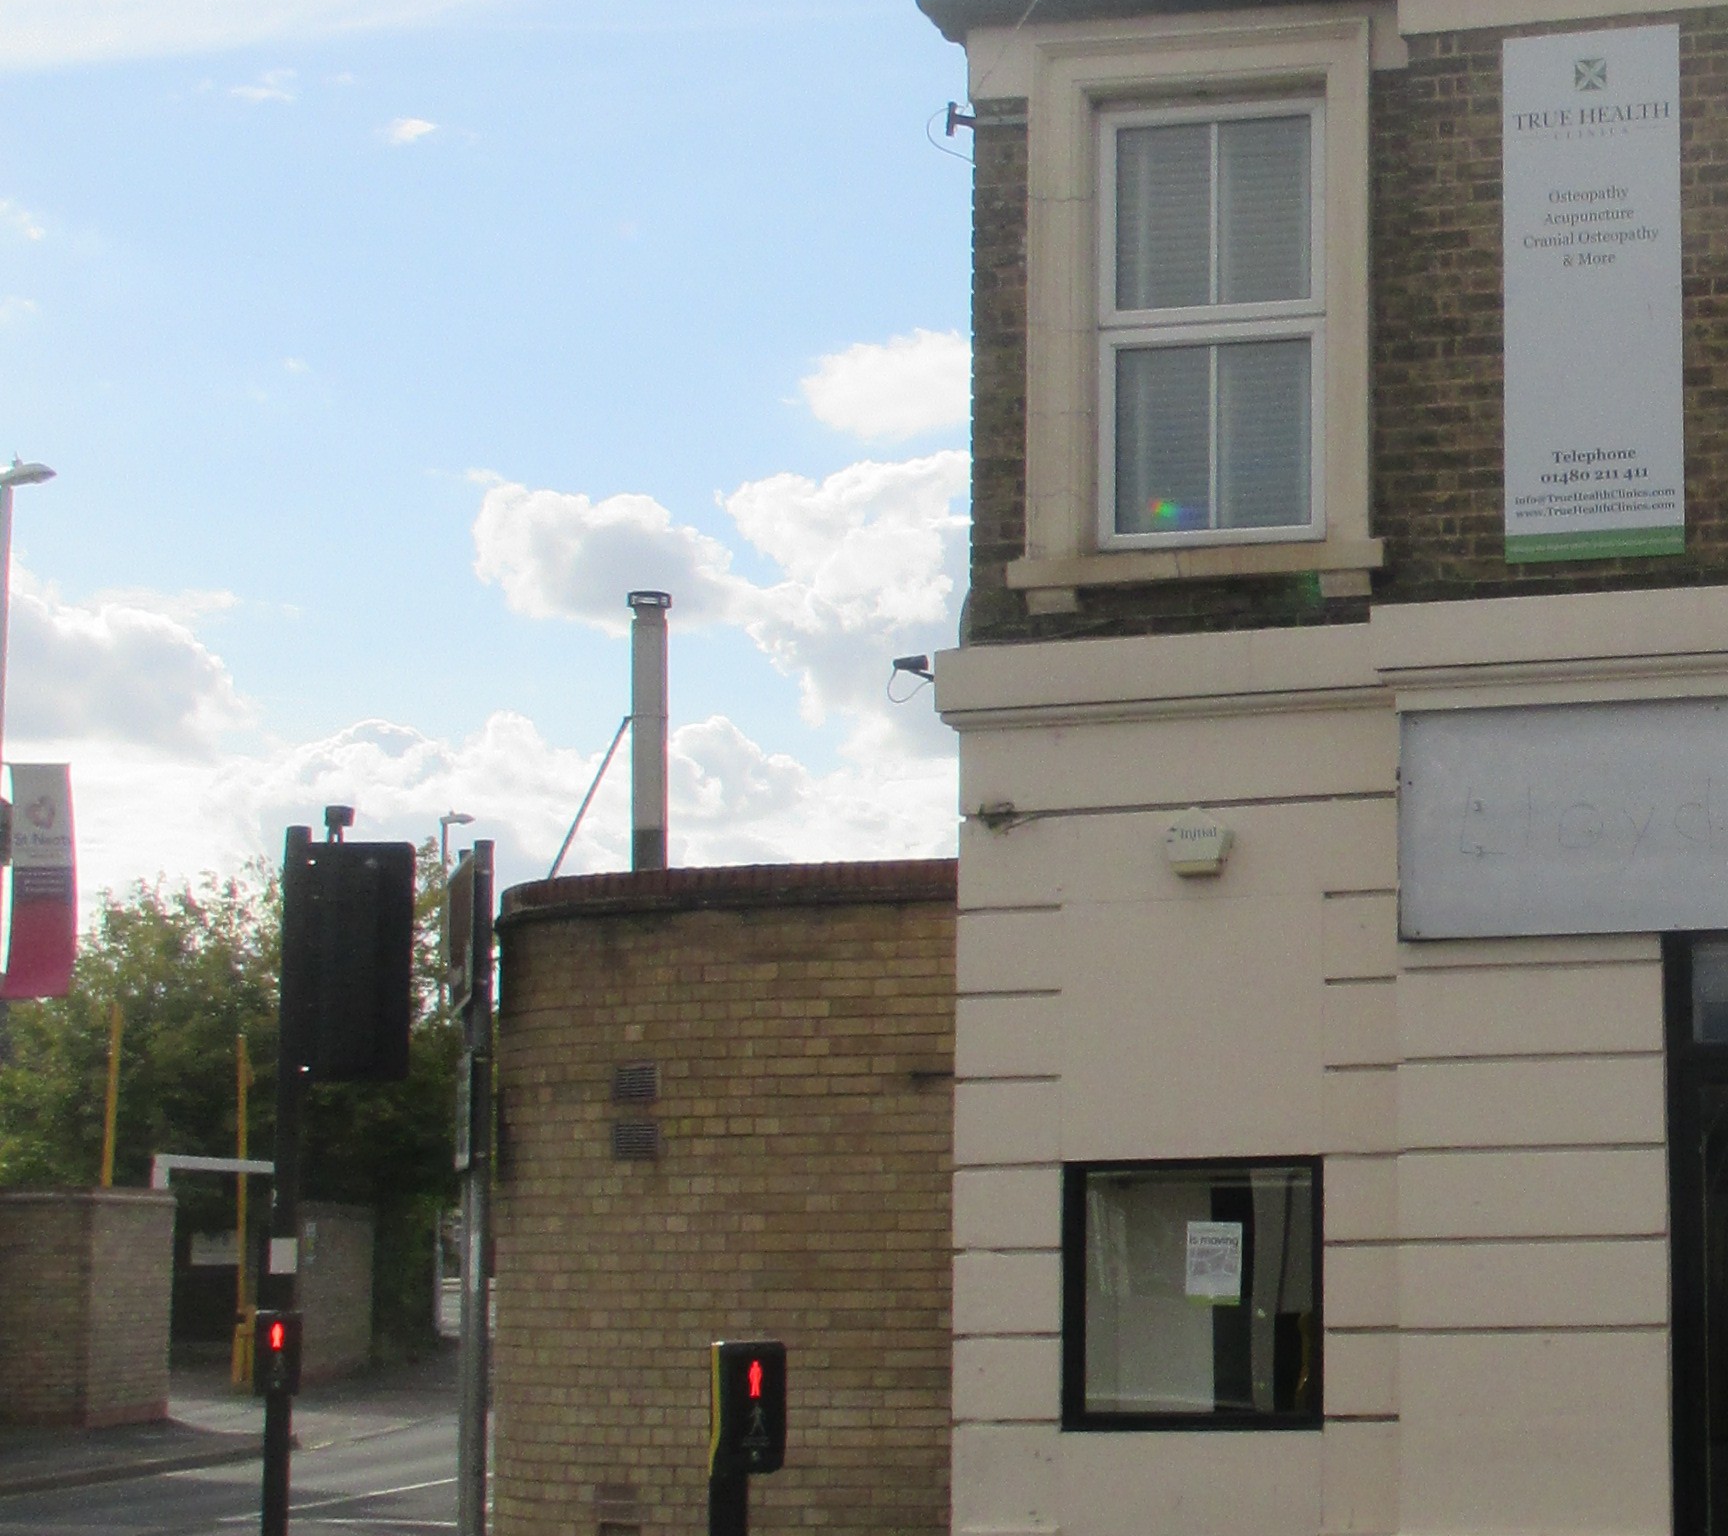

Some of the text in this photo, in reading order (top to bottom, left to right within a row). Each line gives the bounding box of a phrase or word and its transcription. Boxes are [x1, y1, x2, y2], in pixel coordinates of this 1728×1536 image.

[1512, 101, 1670, 131] TRUE HEALTH
[1548, 185, 1629, 204] Osteopathy
[1544, 208, 1635, 226] Acupuncture
[1523, 225, 1659, 249] Cranial Osteopathy
[1562, 252, 1616, 267] & More
[1551, 447, 1637, 465] Telephone
[1540, 467, 1649, 485] 01480 211 411
[1514, 487, 1676, 506] info@TrueHealthClinics.com
[1515, 501, 1676, 519] www.TrueHealthClinics.com
